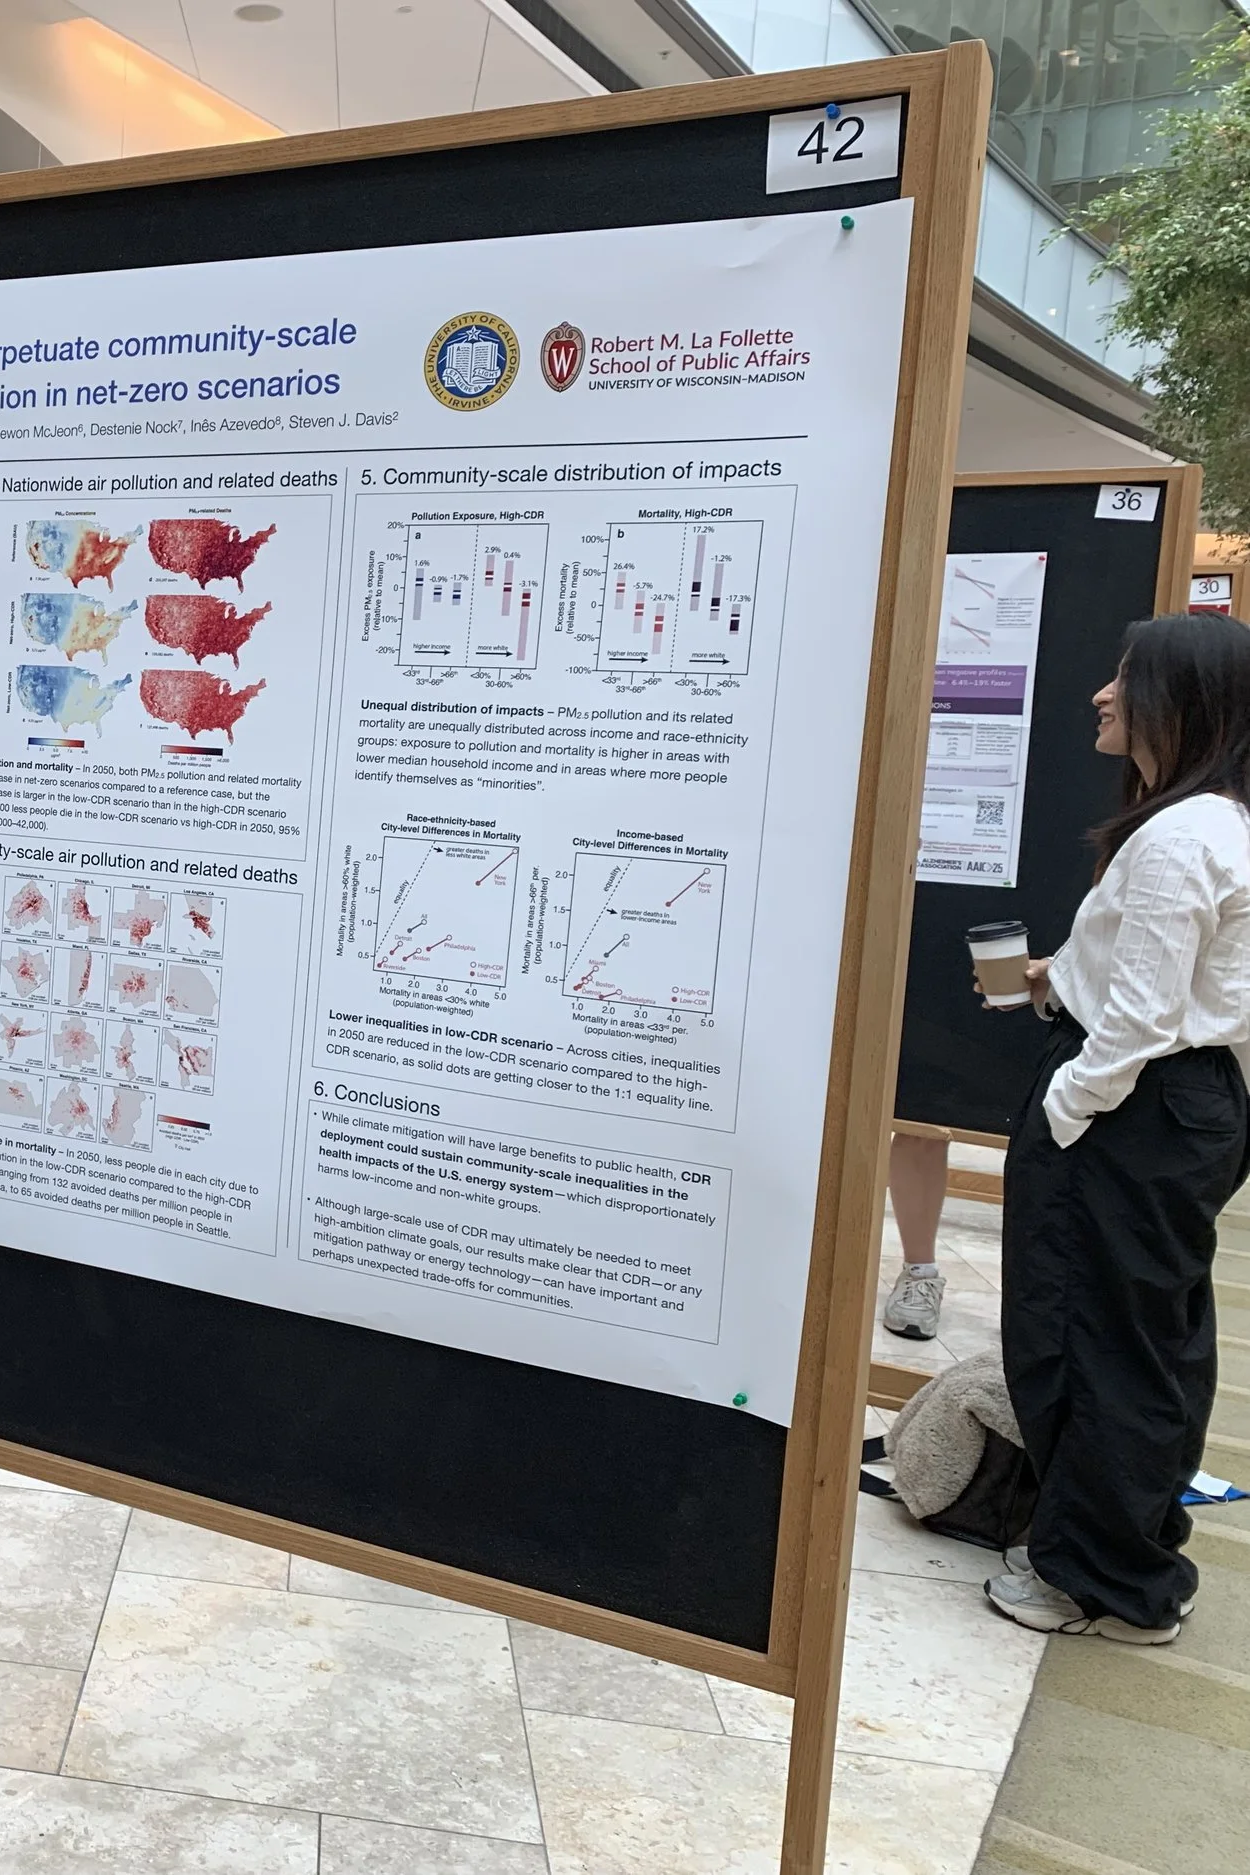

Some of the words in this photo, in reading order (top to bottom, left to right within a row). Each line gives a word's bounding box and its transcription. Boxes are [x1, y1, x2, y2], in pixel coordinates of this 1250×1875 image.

[797, 115, 866, 165] 42
[479, 315, 496, 325] OF
[108, 317, 357, 359] community-scale
[428, 315, 477, 373] UNIVERSITY
[591, 335, 655, 354] Robert
[660, 333, 684, 351] M.
[691, 332, 713, 350] La
[719, 328, 794, 348] Follette
[497, 323, 517, 394] CALIFORNIA
[551, 346, 575, 378] W
[588, 355, 651, 375] School
[656, 354, 677, 372] of
[682, 351, 740, 371] Public
[744, 349, 811, 368] Affairs
[477, 369, 499, 379] LIGHT
[588, 378, 655, 391] UNIVERSITY
[656, 377, 673, 388] OF
[46, 382, 67, 407] in
[76, 379, 188, 406] net-zero
[197, 368, 340, 401] scenarios
[428, 376, 444, 399] THE
[449, 397, 491, 409] IRVINE
[90, 421, 142, 437] Destenie
[190, 418, 217, 433] Inês
[288, 414, 335, 429] Steven
[338, 412, 350, 428] J.
[2, 476, 83, 493] Nationwide
[87, 475, 107, 491] air
[111, 474, 178, 495] pollution
[182, 472, 213, 490] and
[218, 471, 275, 489] related
[280, 470, 338, 488] deaths
[361, 469, 377, 486] 5.
[383, 464, 548, 488] Community-scale
[554, 462, 665, 482] distribution
[672, 460, 694, 480] of
[699, 459, 782, 483] impacts
[638, 509, 682, 520] Mortality,
[684, 507, 733, 520] High-CDR
[1111, 490, 1143, 511] 36
[411, 511, 450, 521] Pollution
[452, 511, 497, 522] Exposure,
[499, 510, 545, 522] High-CDR
[1198, 579, 1220, 595] 30
[978, 668, 1007, 677] profiles
[990, 679, 1012, 687] faster
[354, 769, 394, 785] identify
[395, 772, 458, 786] themselves
[460, 778, 474, 787] as
[58, 848, 77, 864] air
[80, 851, 145, 870] pollution
[150, 858, 179, 874] and
[184, 860, 238, 879] related
[242, 865, 298, 885] deaths
[314, 1080, 328, 1103] 6.
[334, 1083, 440, 1117] Conclusions
[321, 1110, 350, 1125] While
[351, 1117, 390, 1133] climate
[392, 1124, 445, 1142] mitigation
[447, 1134, 466, 1146] will
[468, 1136, 496, 1151] have
[498, 1141, 527, 1158] large
[529, 1147, 577, 1165] benefits
[579, 1155, 592, 1167] to
[595, 1159, 633, 1173] public
[636, 1163, 677, 1182] health,
[680, 1170, 711, 1186] CDR
[320, 1128, 384, 1149] deployment
[386, 1142, 419, 1156] could
[421, 1148, 463, 1164] sustain
[466, 1157, 572, 1182] community-scale
[575, 1172, 649, 1195] inequalities
[652, 1185, 664, 1197] in
[667, 1188, 689, 1201] the
[318, 1145, 352, 1161] health
[354, 1152, 400, 1170] impacts
[402, 1162, 414, 1173] of
[416, 1164, 436, 1177] the
[438, 1167, 462, 1182] U.S.
[465, 1175, 507, 1191] energy
[605, 1197, 716, 1227] disproportionately
[10, 1184, 20, 1195] to
[20, 1186, 32, 1197] 65
[33, 1191, 69, 1205] avoided
[70, 1196, 102, 1211] deaths
[103, 1204, 120, 1214] per
[121, 1207, 151, 1221] million
[152, 1214, 184, 1229] people
[185, 1219, 194, 1231] in
[196, 1222, 231, 1239] Seattle.
